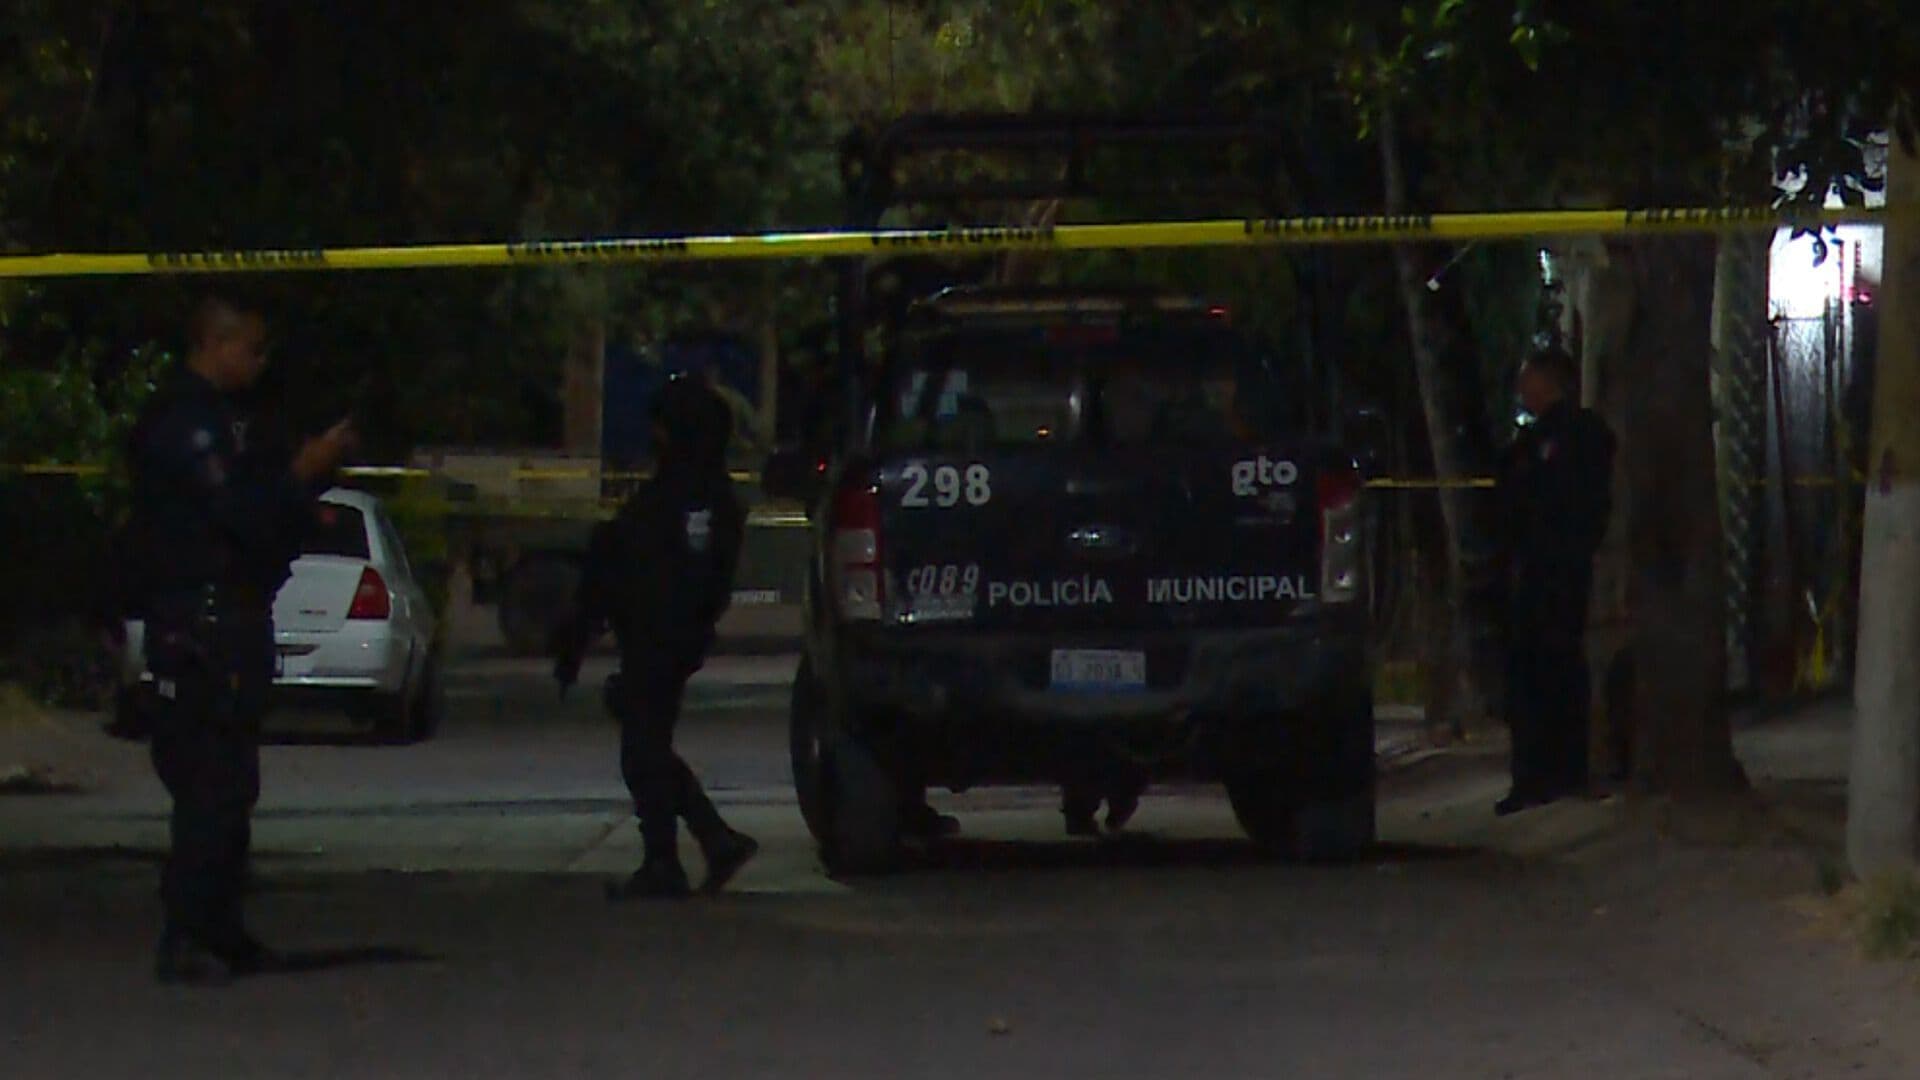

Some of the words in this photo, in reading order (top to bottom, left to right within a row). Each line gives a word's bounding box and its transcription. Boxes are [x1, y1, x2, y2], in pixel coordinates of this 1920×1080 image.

[901, 463, 992, 508] 298
[1232, 456, 1299, 496] gto
[1146, 575, 1316, 603] MUNICIPAL
